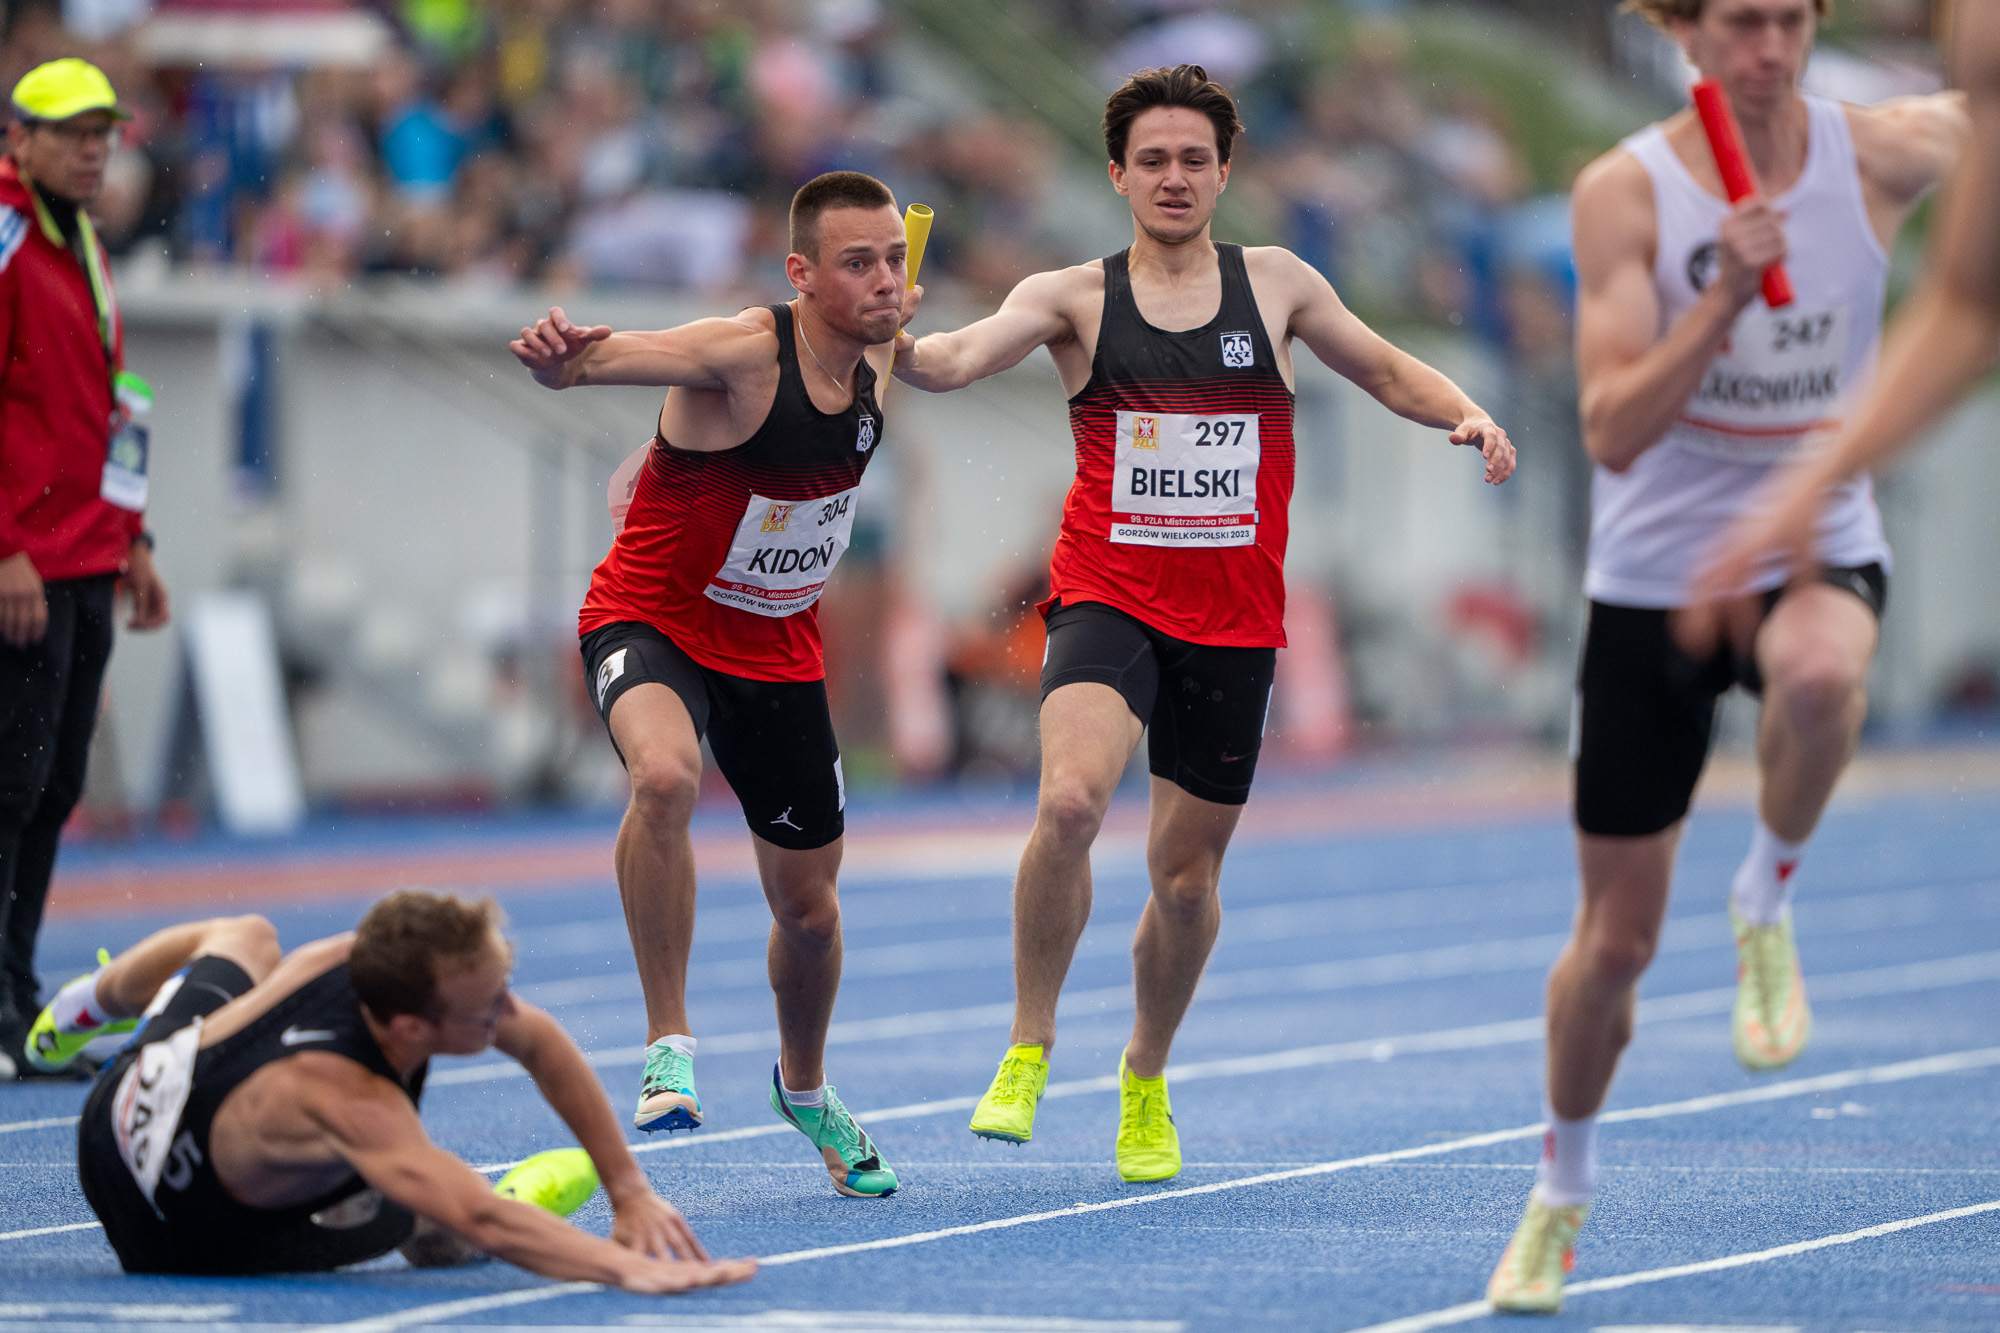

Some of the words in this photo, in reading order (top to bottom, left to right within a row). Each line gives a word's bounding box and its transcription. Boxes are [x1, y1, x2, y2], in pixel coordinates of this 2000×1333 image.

[1773, 312, 1834, 351] 247
[1195, 421, 1246, 447] 297
[1133, 438, 1158, 449] PZLA
[1131, 467, 1240, 498] BIELSKI
[817, 494, 851, 527] 304
[763, 522, 785, 532] PZLA
[1130, 514, 1143, 524] 99.
[1144, 515, 1163, 525] PZLA
[1164, 517, 1217, 526] Mistrzostwa
[1218, 515, 1240, 525] Polski
[1118, 529, 1160, 539] GORZÓW
[1161, 531, 1229, 540] WIELKOPOLSKI
[1230, 530, 1250, 538] 2023
[747, 536, 835, 575] KIDOŃ
[713, 590, 757, 606] GORZÓW
[745, 586, 765, 597] PZLA
[767, 589, 806, 600] Mistrzostwa
